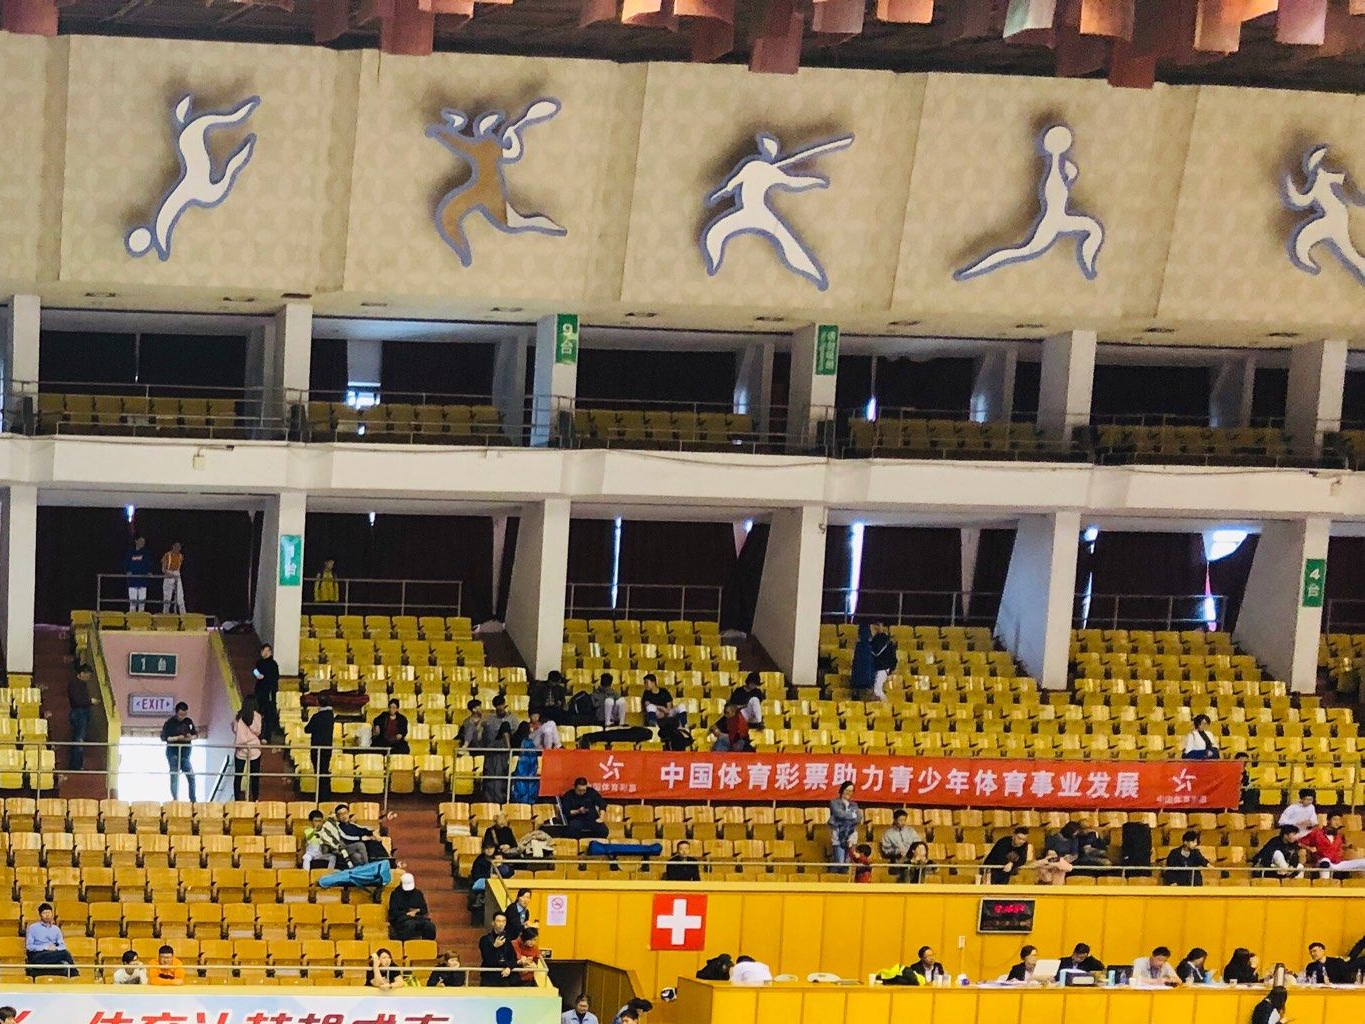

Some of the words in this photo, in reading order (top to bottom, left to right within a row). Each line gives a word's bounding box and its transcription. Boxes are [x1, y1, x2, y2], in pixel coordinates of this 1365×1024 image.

[142, 698, 165, 710] EXIT
[660, 762, 1139, 799] 中国体育彩票助力青少年体育事业发展
